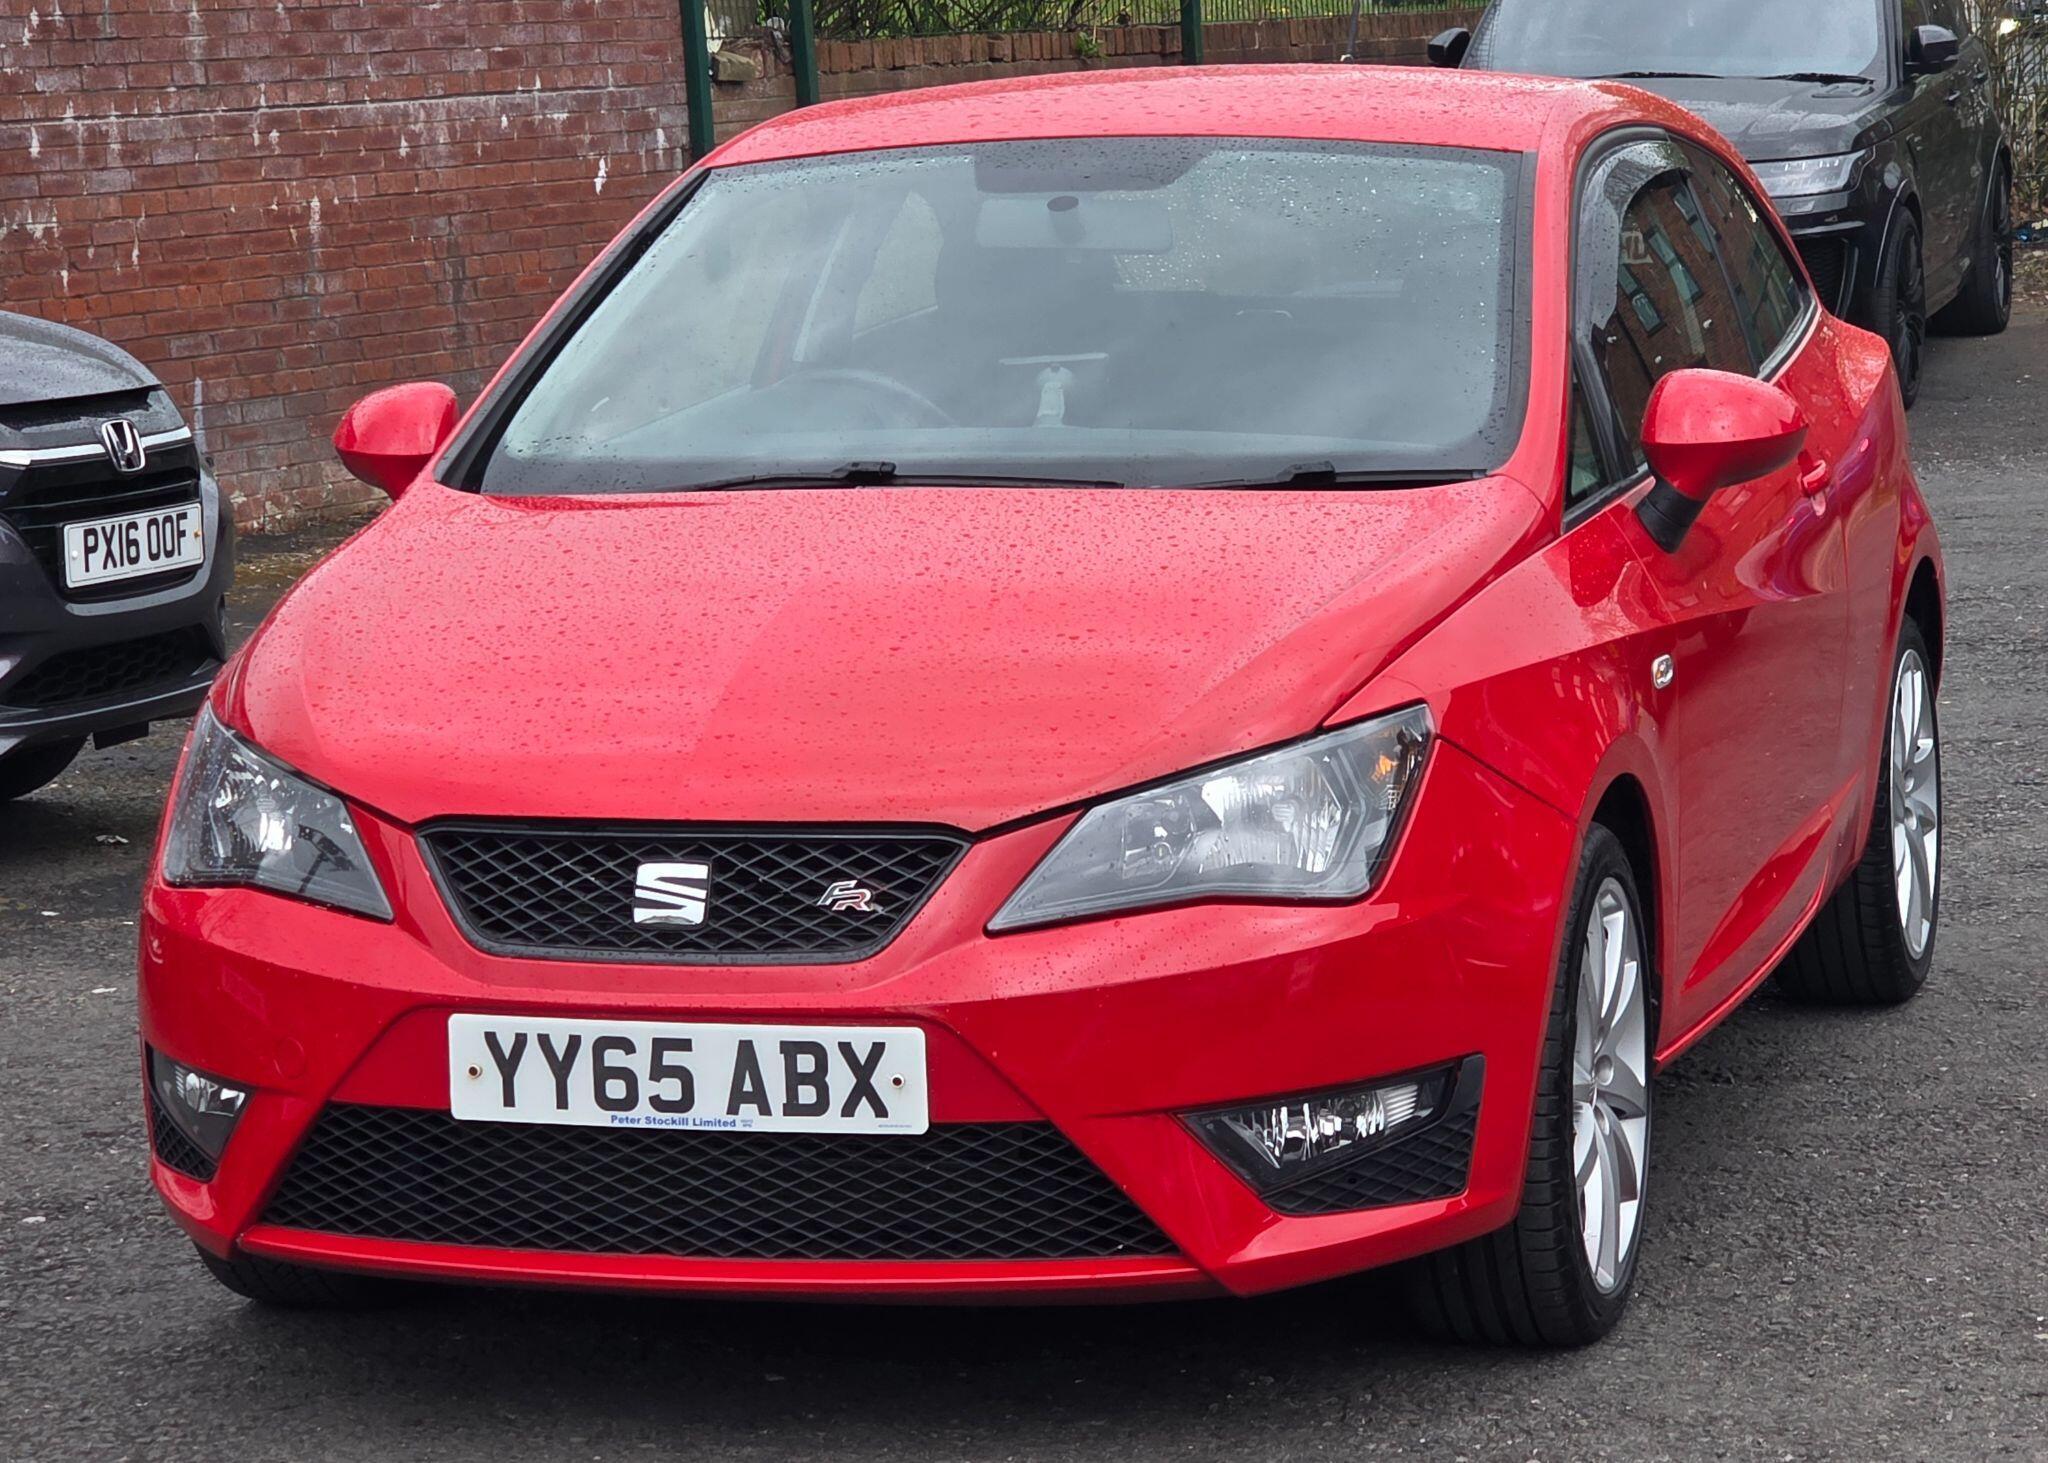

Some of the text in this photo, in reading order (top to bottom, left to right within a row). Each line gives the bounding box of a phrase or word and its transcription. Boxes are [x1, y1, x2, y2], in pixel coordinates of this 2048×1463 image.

[83, 512, 188, 573] PX16 OOF
[816, 879, 874, 912] FR
[484, 1031, 889, 1119] YY65 ABX
[610, 1114, 641, 1125] Peter
[644, 1116, 689, 1127] Stockill
[692, 1118, 737, 1128] Limited
